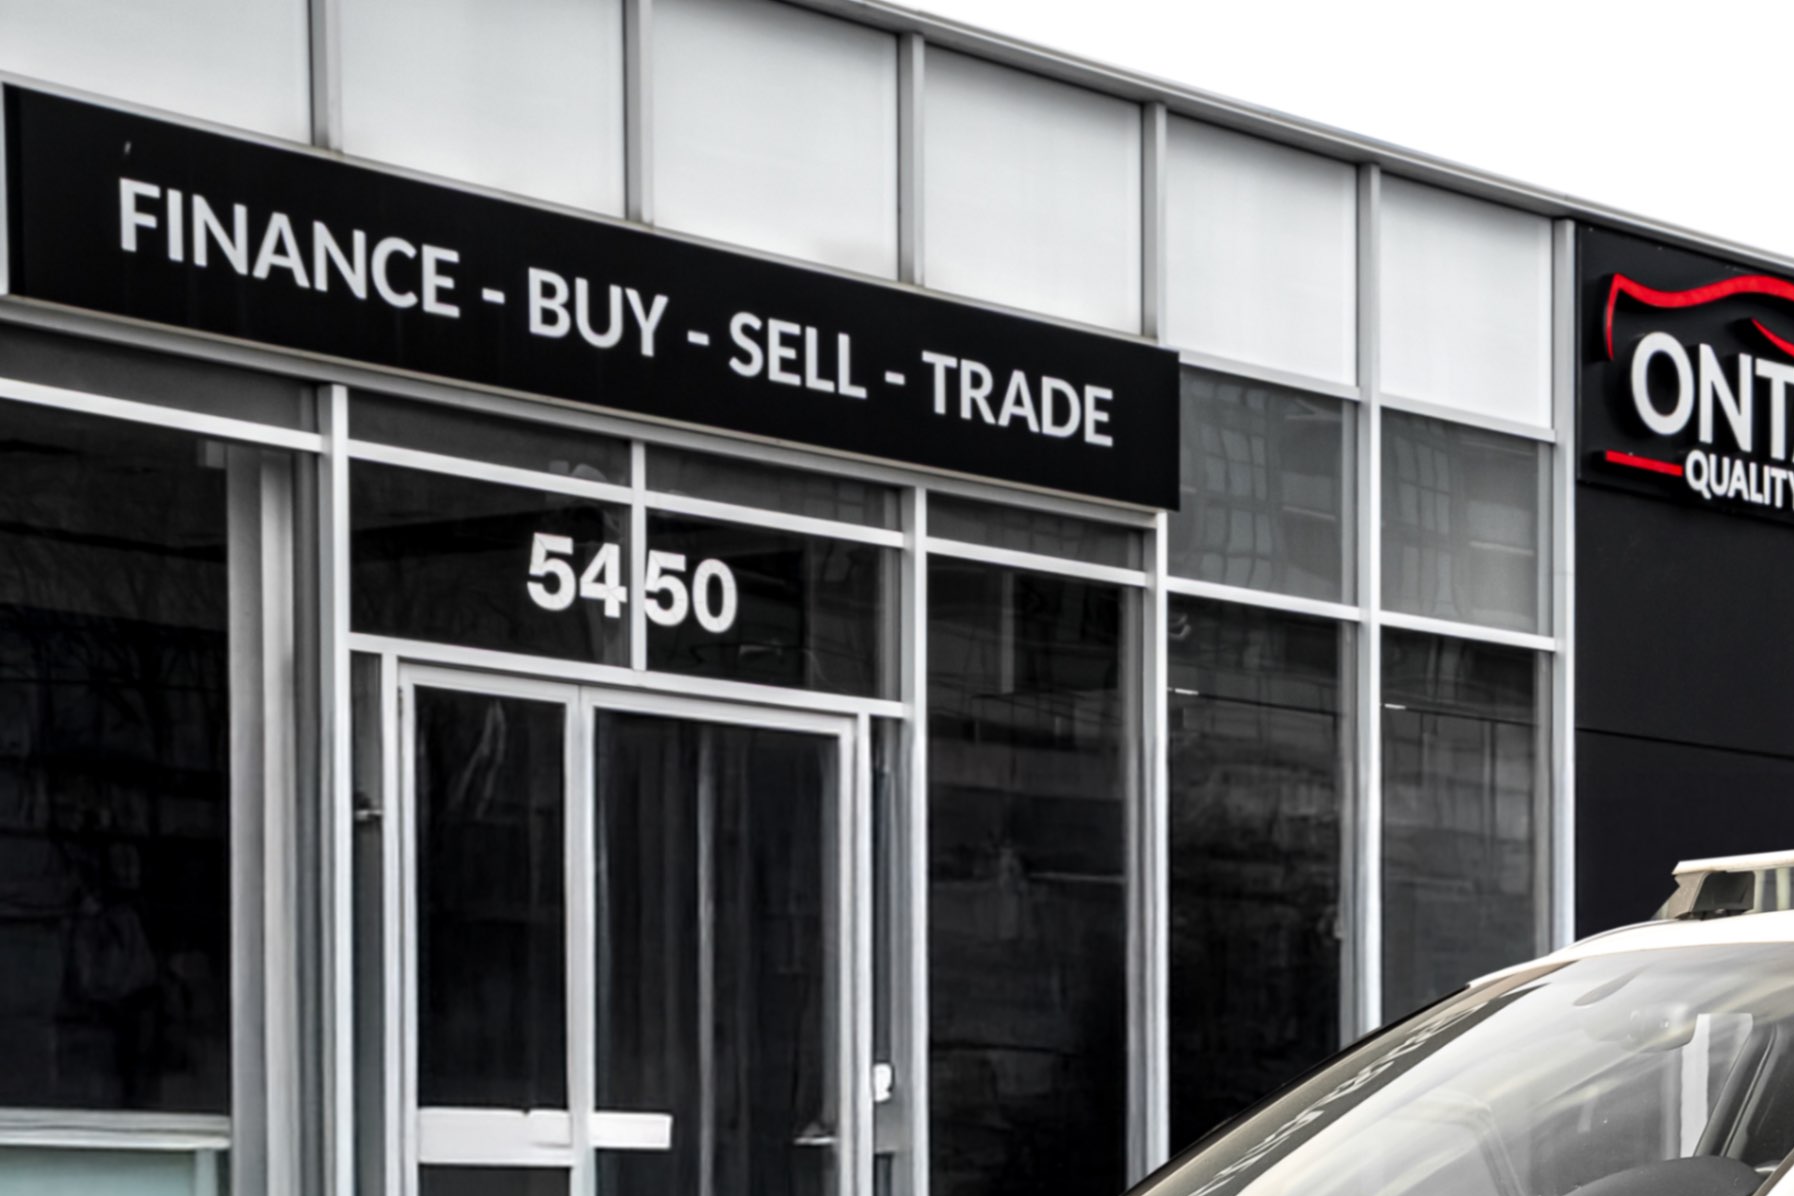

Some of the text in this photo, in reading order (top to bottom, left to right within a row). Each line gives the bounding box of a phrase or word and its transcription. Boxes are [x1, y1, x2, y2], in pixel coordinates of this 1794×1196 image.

[117, 176, 461, 319] FINANCE
[528, 267, 669, 357] BUY
[729, 311, 867, 399] SELL
[921, 350, 1114, 447] TRADE
[527, 531, 738, 633] 5450
